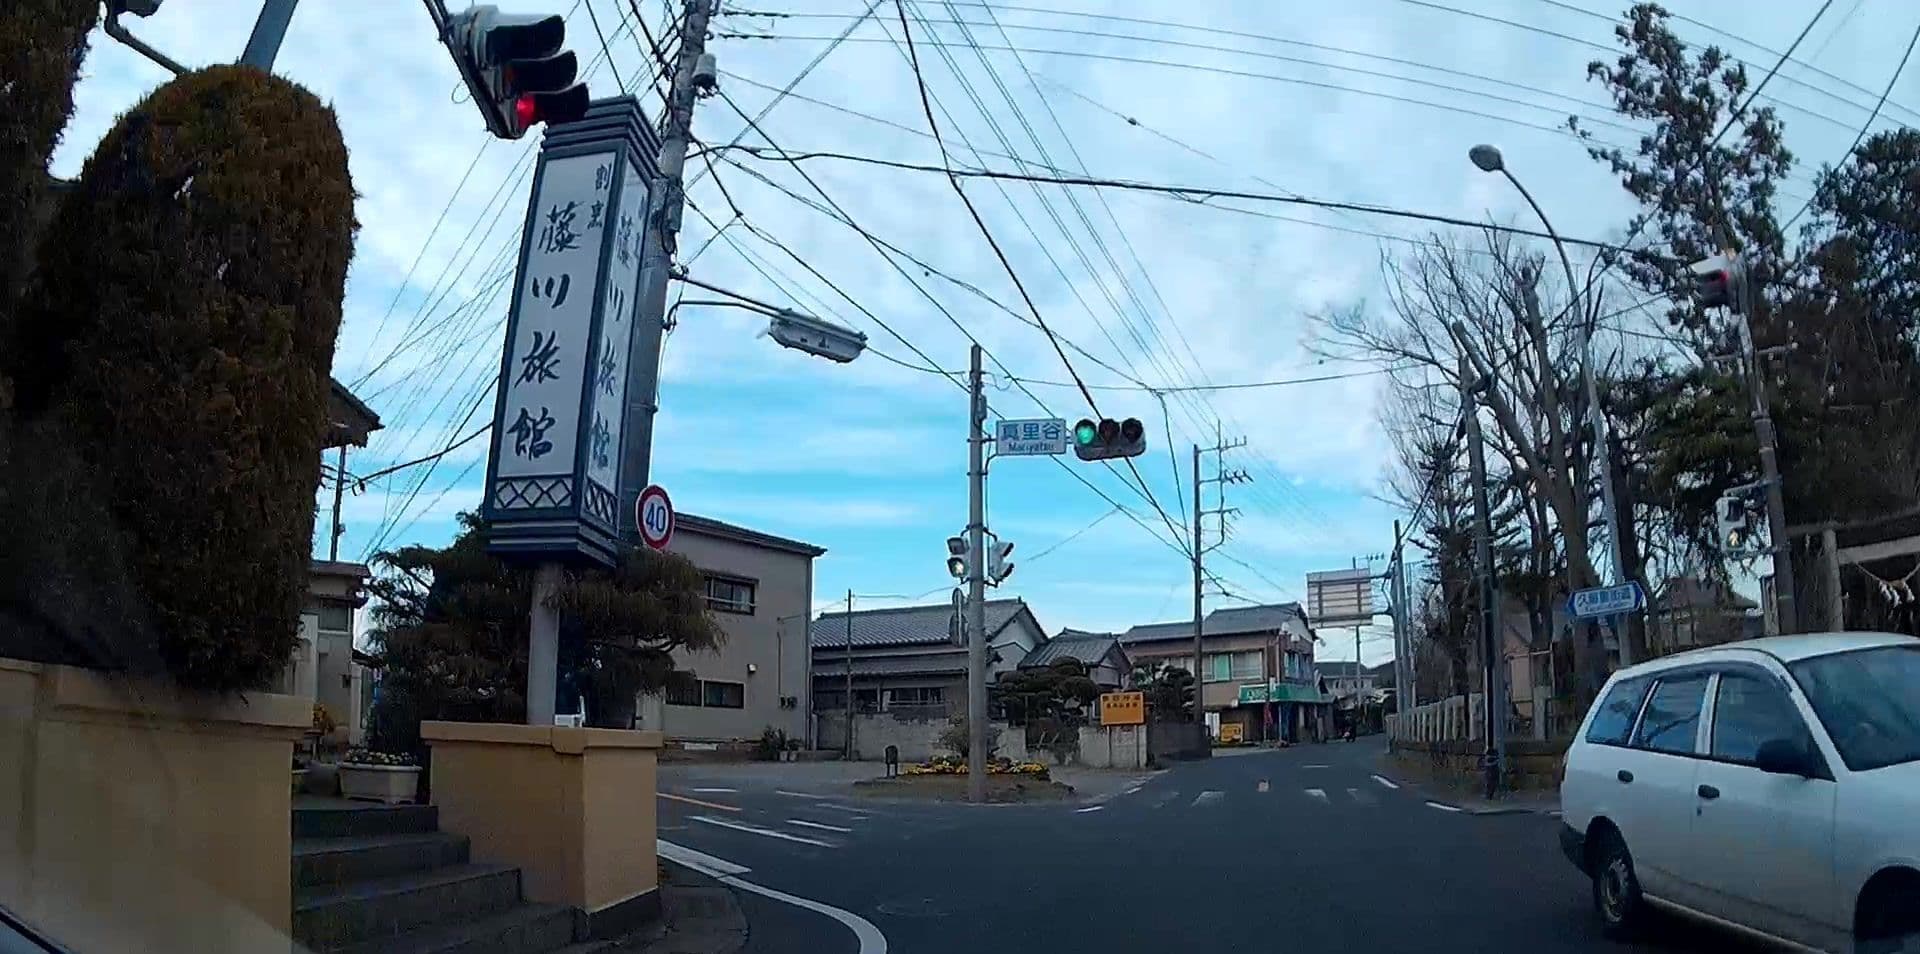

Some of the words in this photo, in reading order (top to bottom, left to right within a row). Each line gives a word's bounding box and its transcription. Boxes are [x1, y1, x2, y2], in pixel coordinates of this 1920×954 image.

[506, 200, 583, 462] 藤川旅館
[591, 209, 633, 468] 藤川旅館
[1001, 422, 1062, 441] 真里谷
[646, 503, 666, 532] 40
